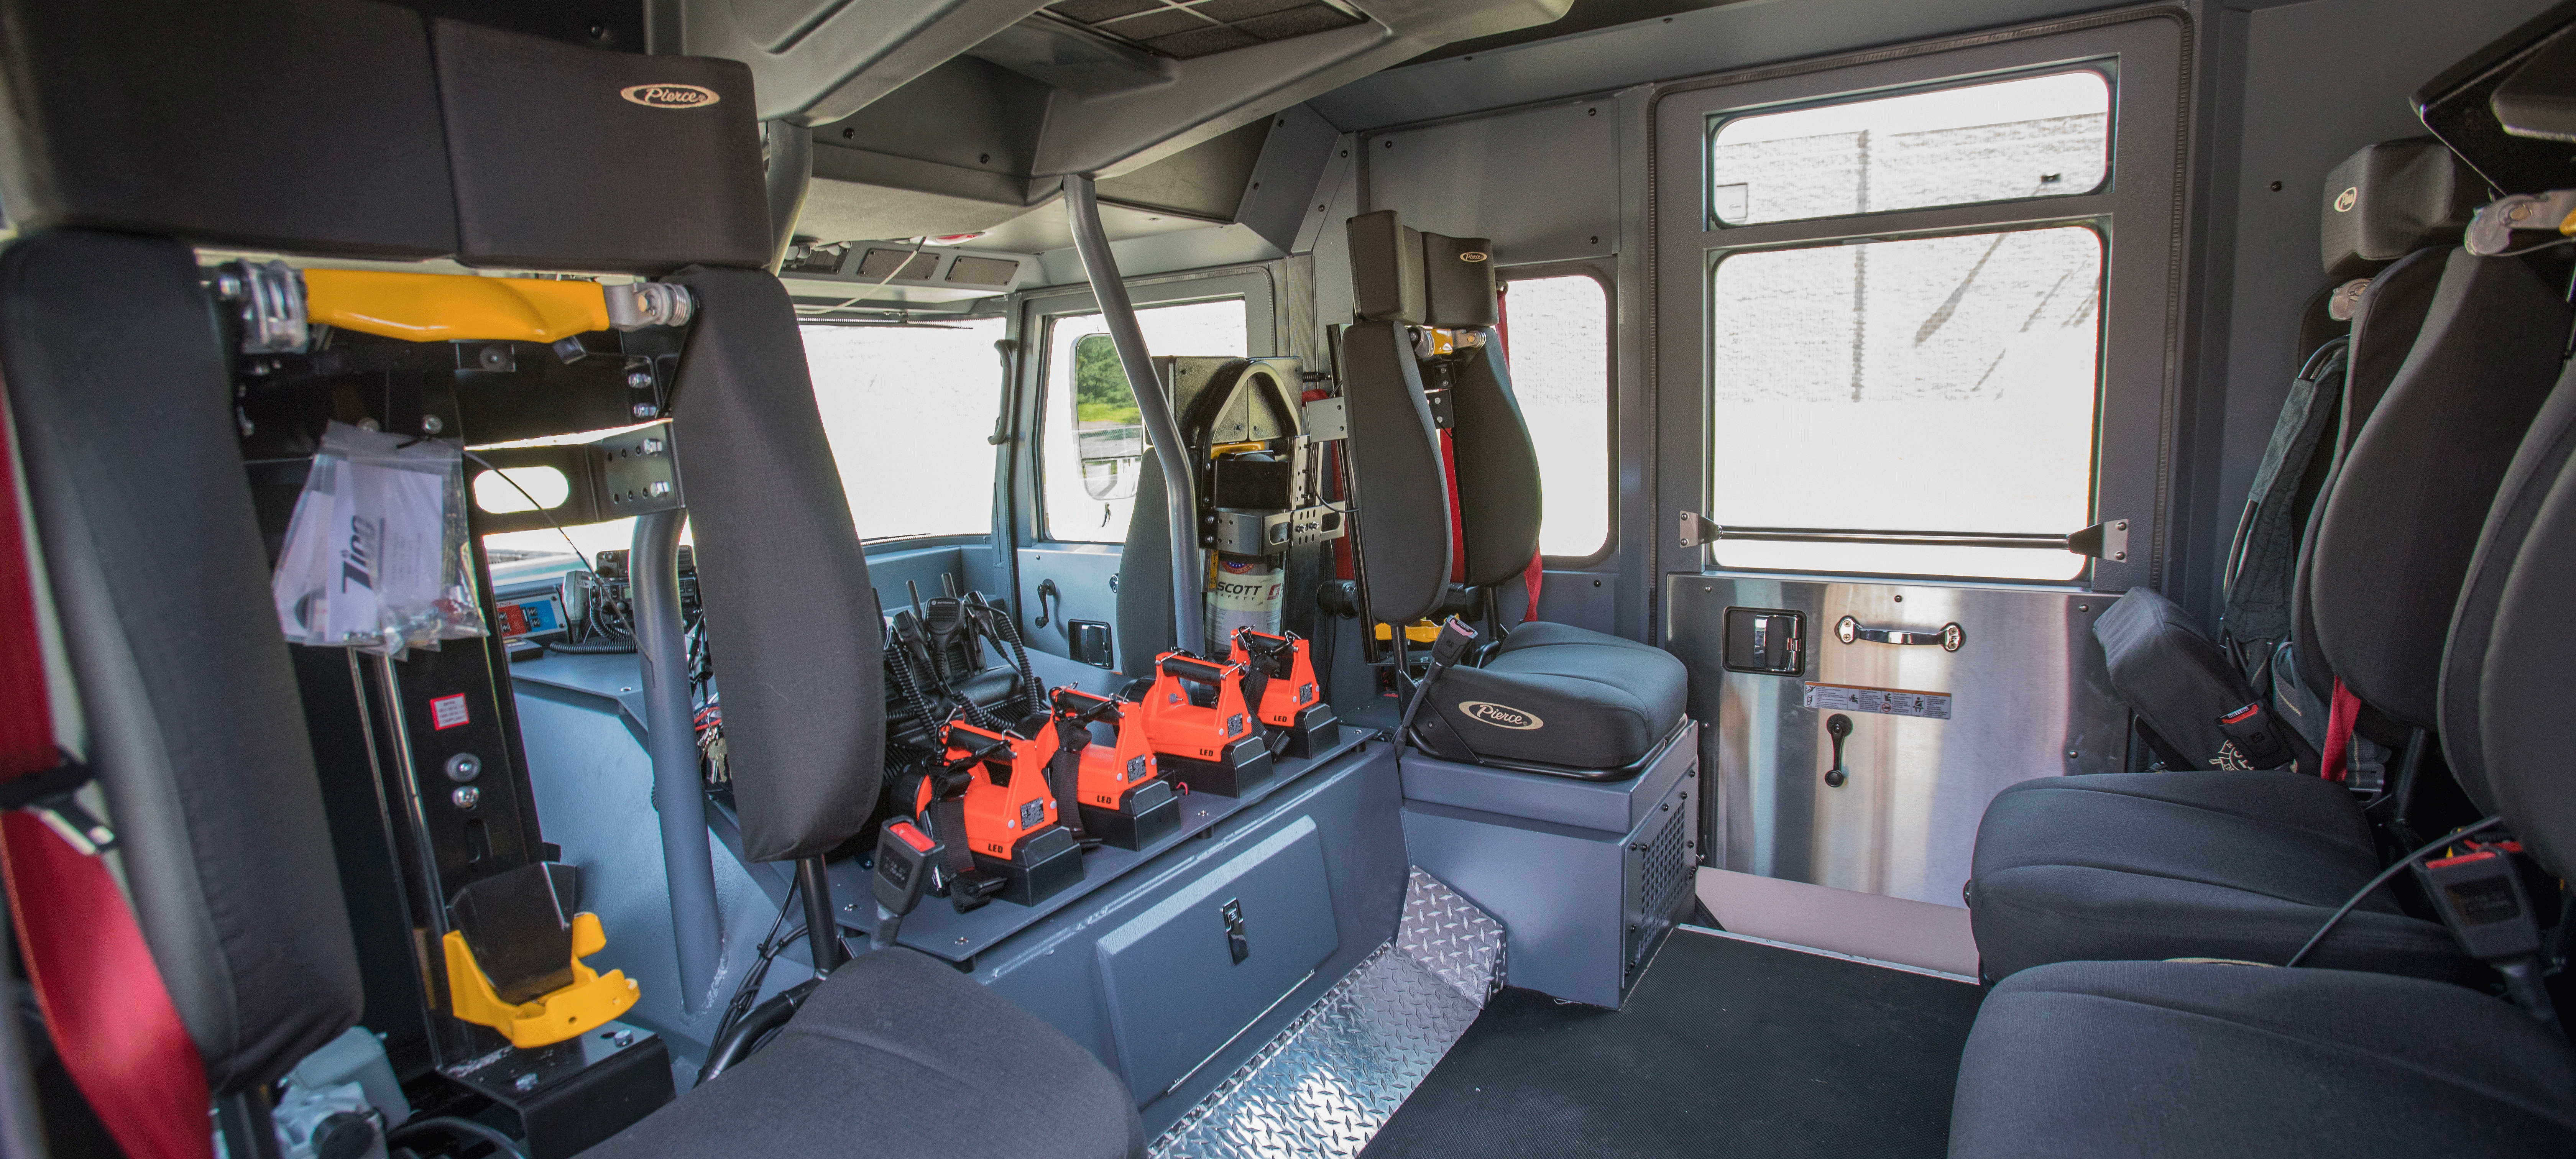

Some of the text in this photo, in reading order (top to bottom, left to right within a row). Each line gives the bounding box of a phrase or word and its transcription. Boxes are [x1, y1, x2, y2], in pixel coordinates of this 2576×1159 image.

[1217, 581, 1262, 595] SCOTT
[1199, 749, 1213, 757] LED
[1097, 795, 1111, 804] LED
[988, 843, 1003, 854] LED
